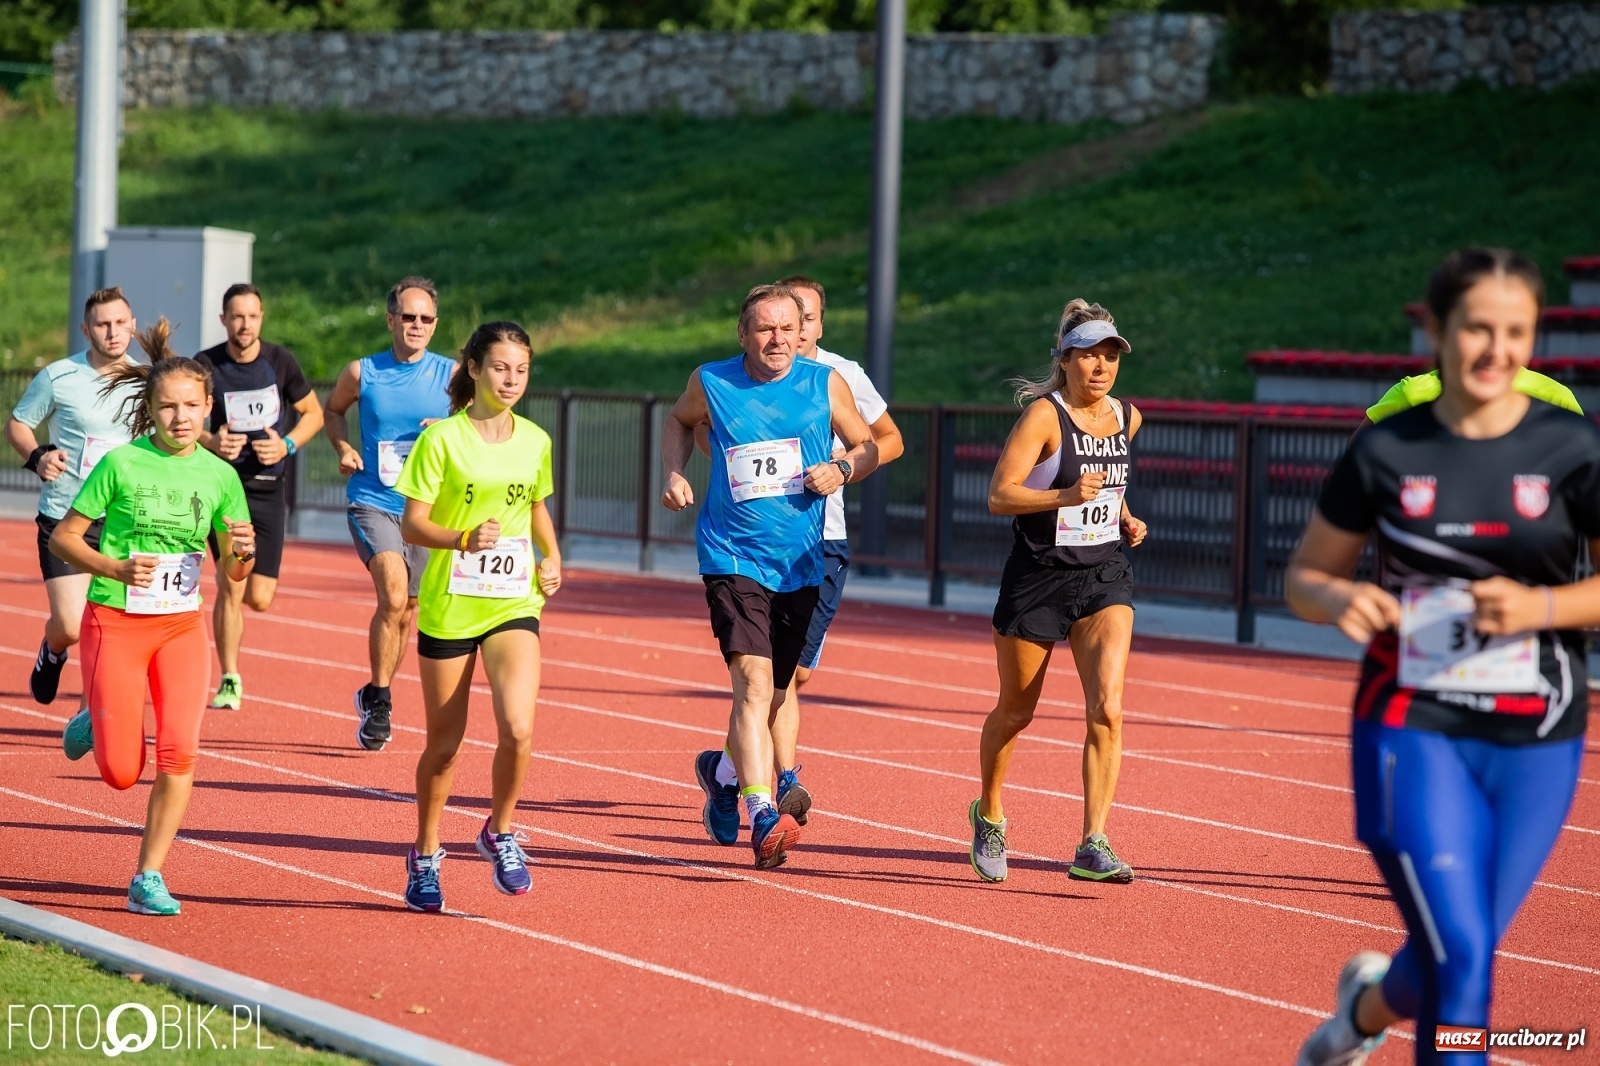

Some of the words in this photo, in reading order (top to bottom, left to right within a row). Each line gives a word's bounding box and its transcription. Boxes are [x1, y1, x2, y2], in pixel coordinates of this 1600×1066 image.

[248, 402, 264, 415] 19
[1071, 433, 1128, 457] LOCALS
[752, 456, 778, 477] 78
[465, 483, 474, 505] 5
[1080, 504, 1109, 525] 103
[478, 554, 514, 575] 120
[162, 571, 182, 591] 14
